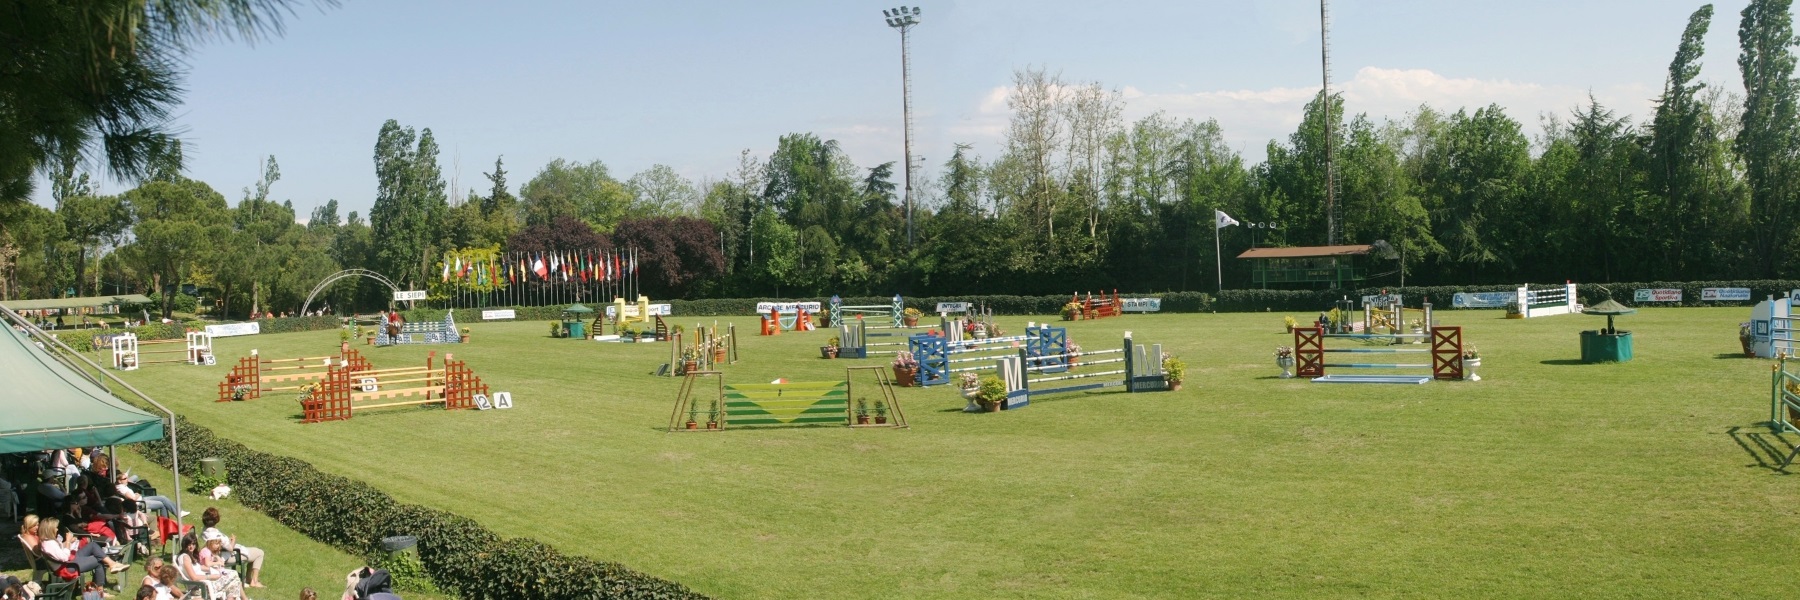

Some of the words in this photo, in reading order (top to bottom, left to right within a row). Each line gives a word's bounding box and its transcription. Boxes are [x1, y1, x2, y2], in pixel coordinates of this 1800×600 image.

[407, 291, 425, 299] SIEPI
[205, 356, 215, 365] 13
[1134, 343, 1162, 377] M
[1003, 356, 1023, 393] M
[474, 395, 491, 409] 12
[498, 393, 509, 408] A
